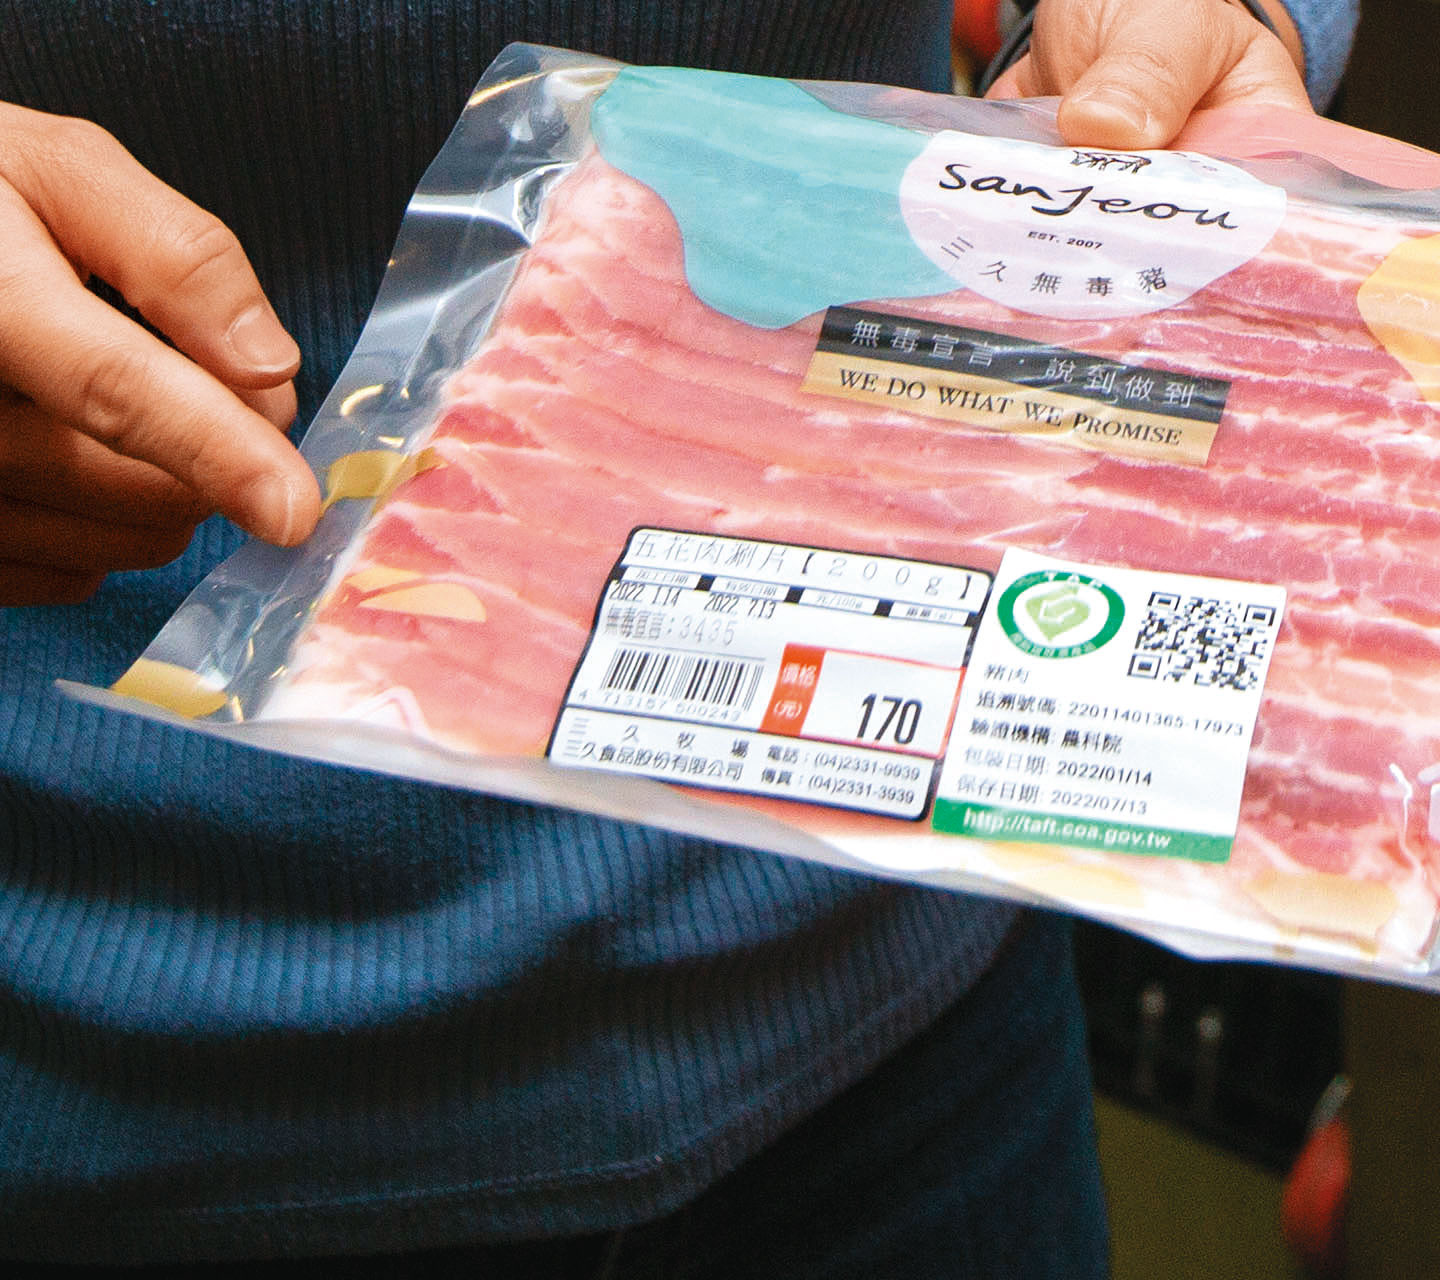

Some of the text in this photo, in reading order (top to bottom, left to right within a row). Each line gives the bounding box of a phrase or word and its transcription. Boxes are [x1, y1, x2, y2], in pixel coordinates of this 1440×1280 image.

[1027, 230, 1104, 251] EST. 2007
[839, 367, 1183, 447] WE DO WHAT WE PROMISE
[857, 692, 922, 745] 170
[1056, 760, 1152, 787] 2022/01/14
[1050, 789, 1148, 816] 2022/07/13
[963, 808, 1173, 848] http://taft.coa.gov.tw
